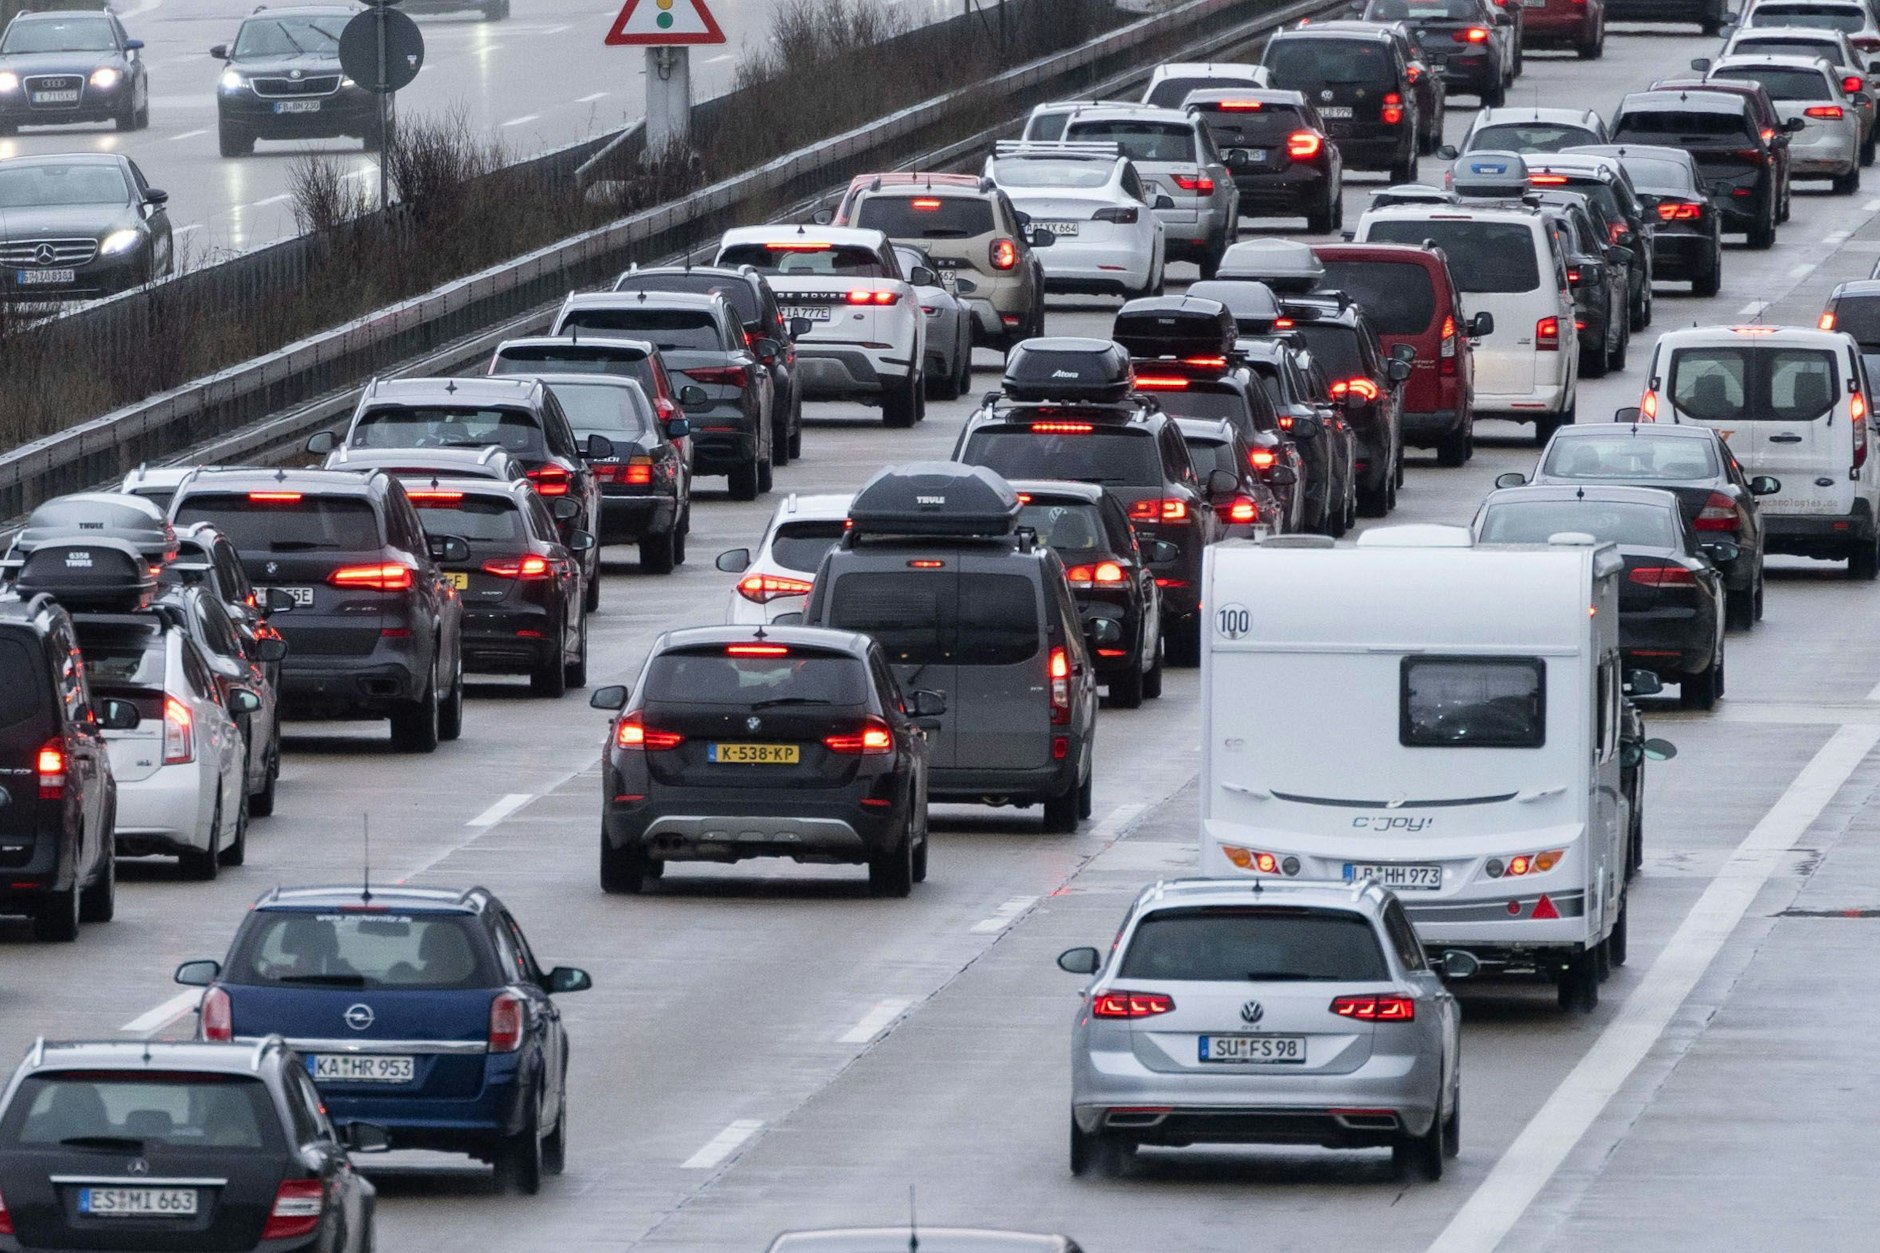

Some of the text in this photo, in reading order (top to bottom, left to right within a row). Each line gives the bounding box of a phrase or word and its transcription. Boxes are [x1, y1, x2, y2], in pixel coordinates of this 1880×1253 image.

[1060, 224, 1076, 232] 664
[916, 496, 945, 504] THULE
[78, 522, 104, 530] THULE
[65, 559, 93, 567] THULE
[1220, 609, 1249, 633] 100
[722, 746, 794, 760] K-538-KP
[1385, 868, 1405, 883] HH
[1409, 868, 1439, 884] 973
[1216, 1040, 1297, 1057] SU FS 98
[317, 1058, 411, 1077] KA HR 953
[92, 1191, 193, 1210] ES MI 663
